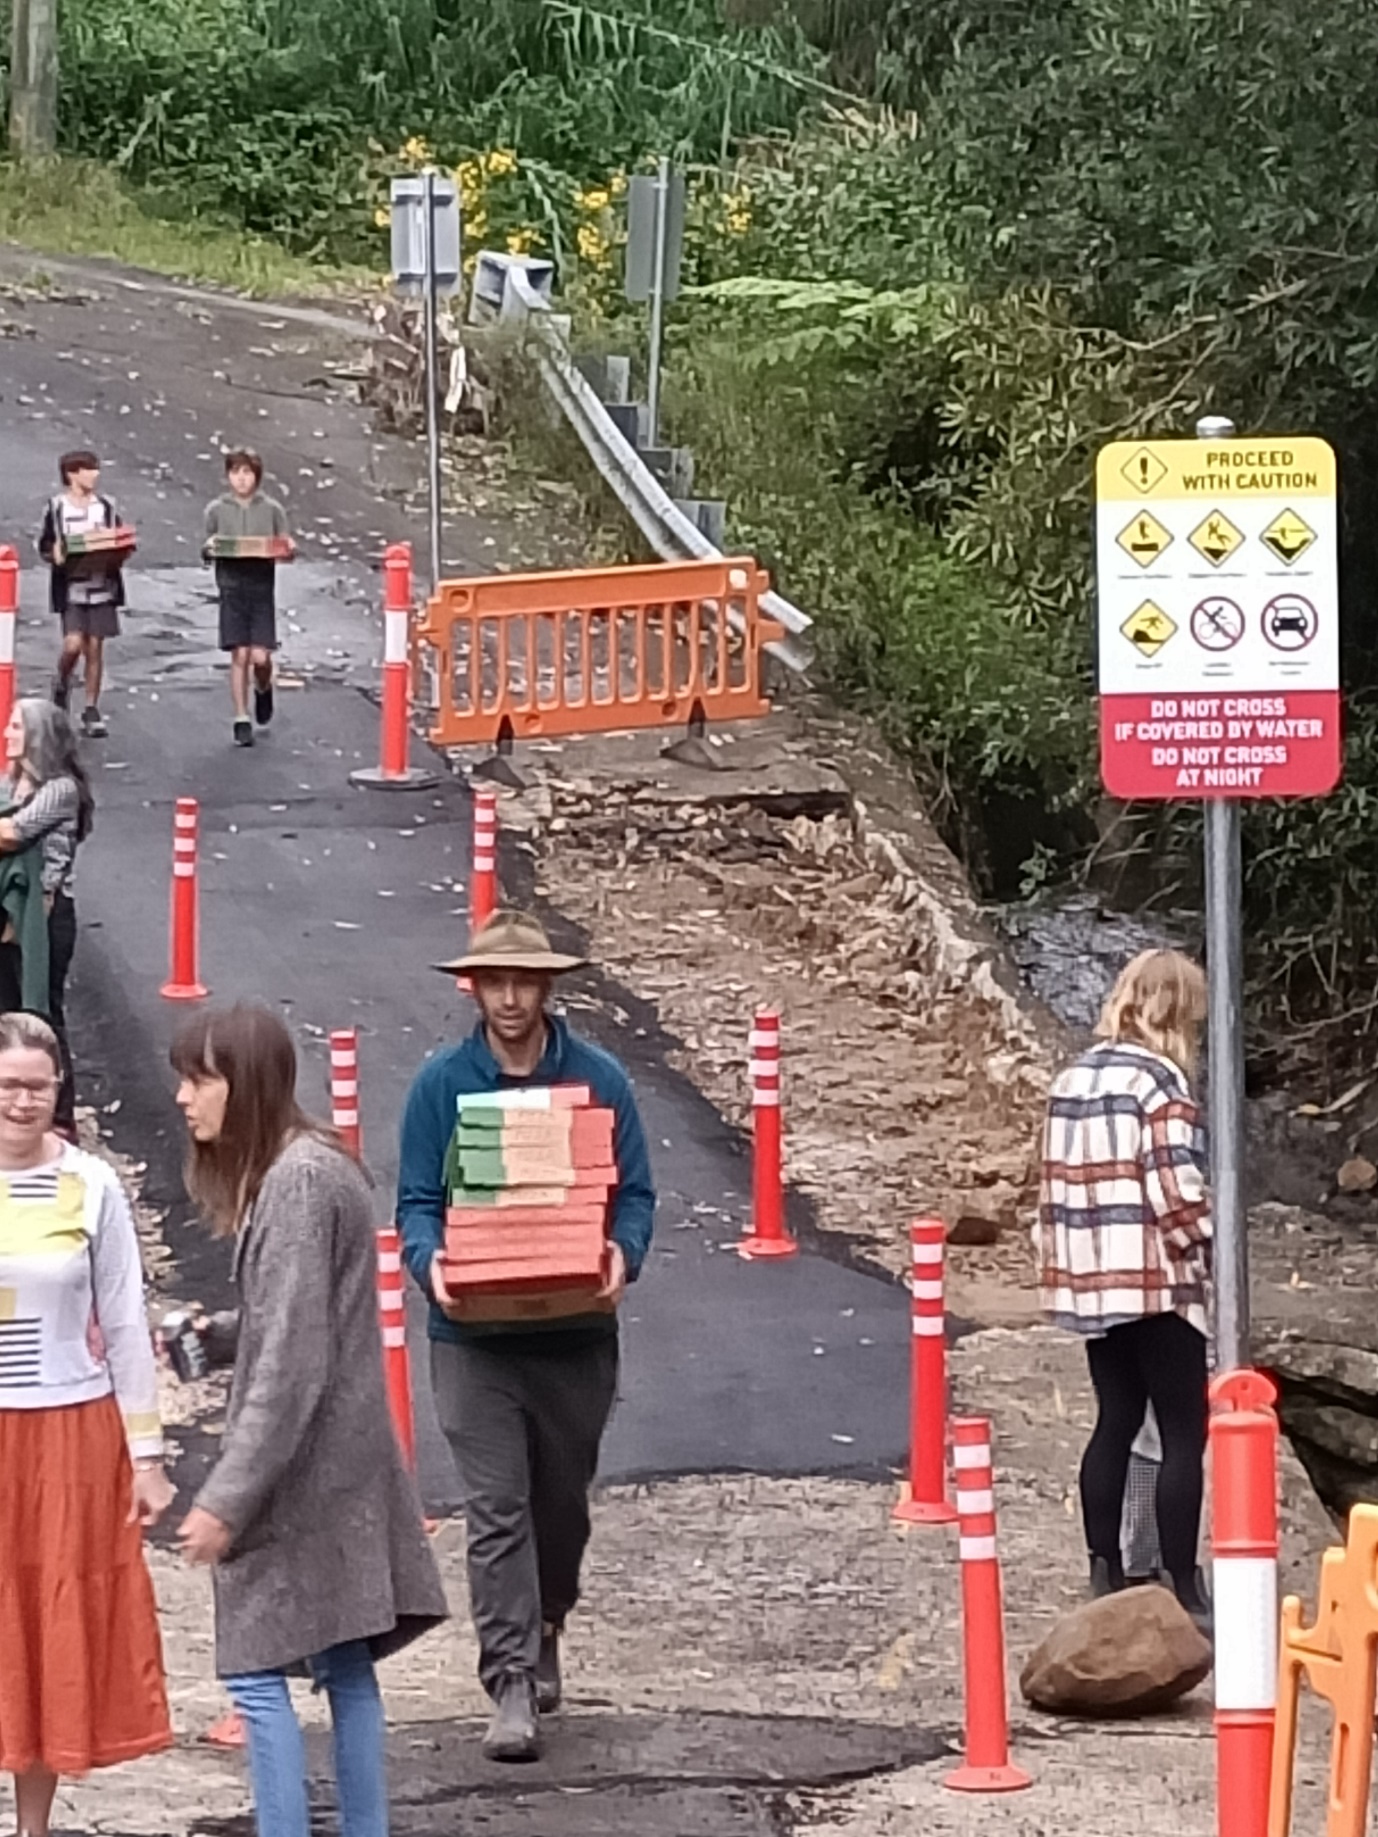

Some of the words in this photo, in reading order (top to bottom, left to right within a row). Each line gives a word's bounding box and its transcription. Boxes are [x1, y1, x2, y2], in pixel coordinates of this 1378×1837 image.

[1206, 451, 1294, 468] PROCEED
[1182, 474, 1230, 490] WITH
[1236, 472, 1318, 490] CAUTION
[1151, 700, 1177, 718] DO
[1181, 699, 1220, 717] NOT
[1224, 698, 1286, 717] CROSS
[1115, 723, 1134, 741] IF
[1137, 721, 1223, 741] COVERED
[1227, 720, 1253, 739] BY
[1256, 719, 1323, 738] WATER
[1151, 748, 1178, 766] DO
[1182, 747, 1221, 765] NOT
[1224, 745, 1287, 764] CROSS
[1176, 769, 1200, 787] AT
[1203, 767, 1263, 786] NIGHT
